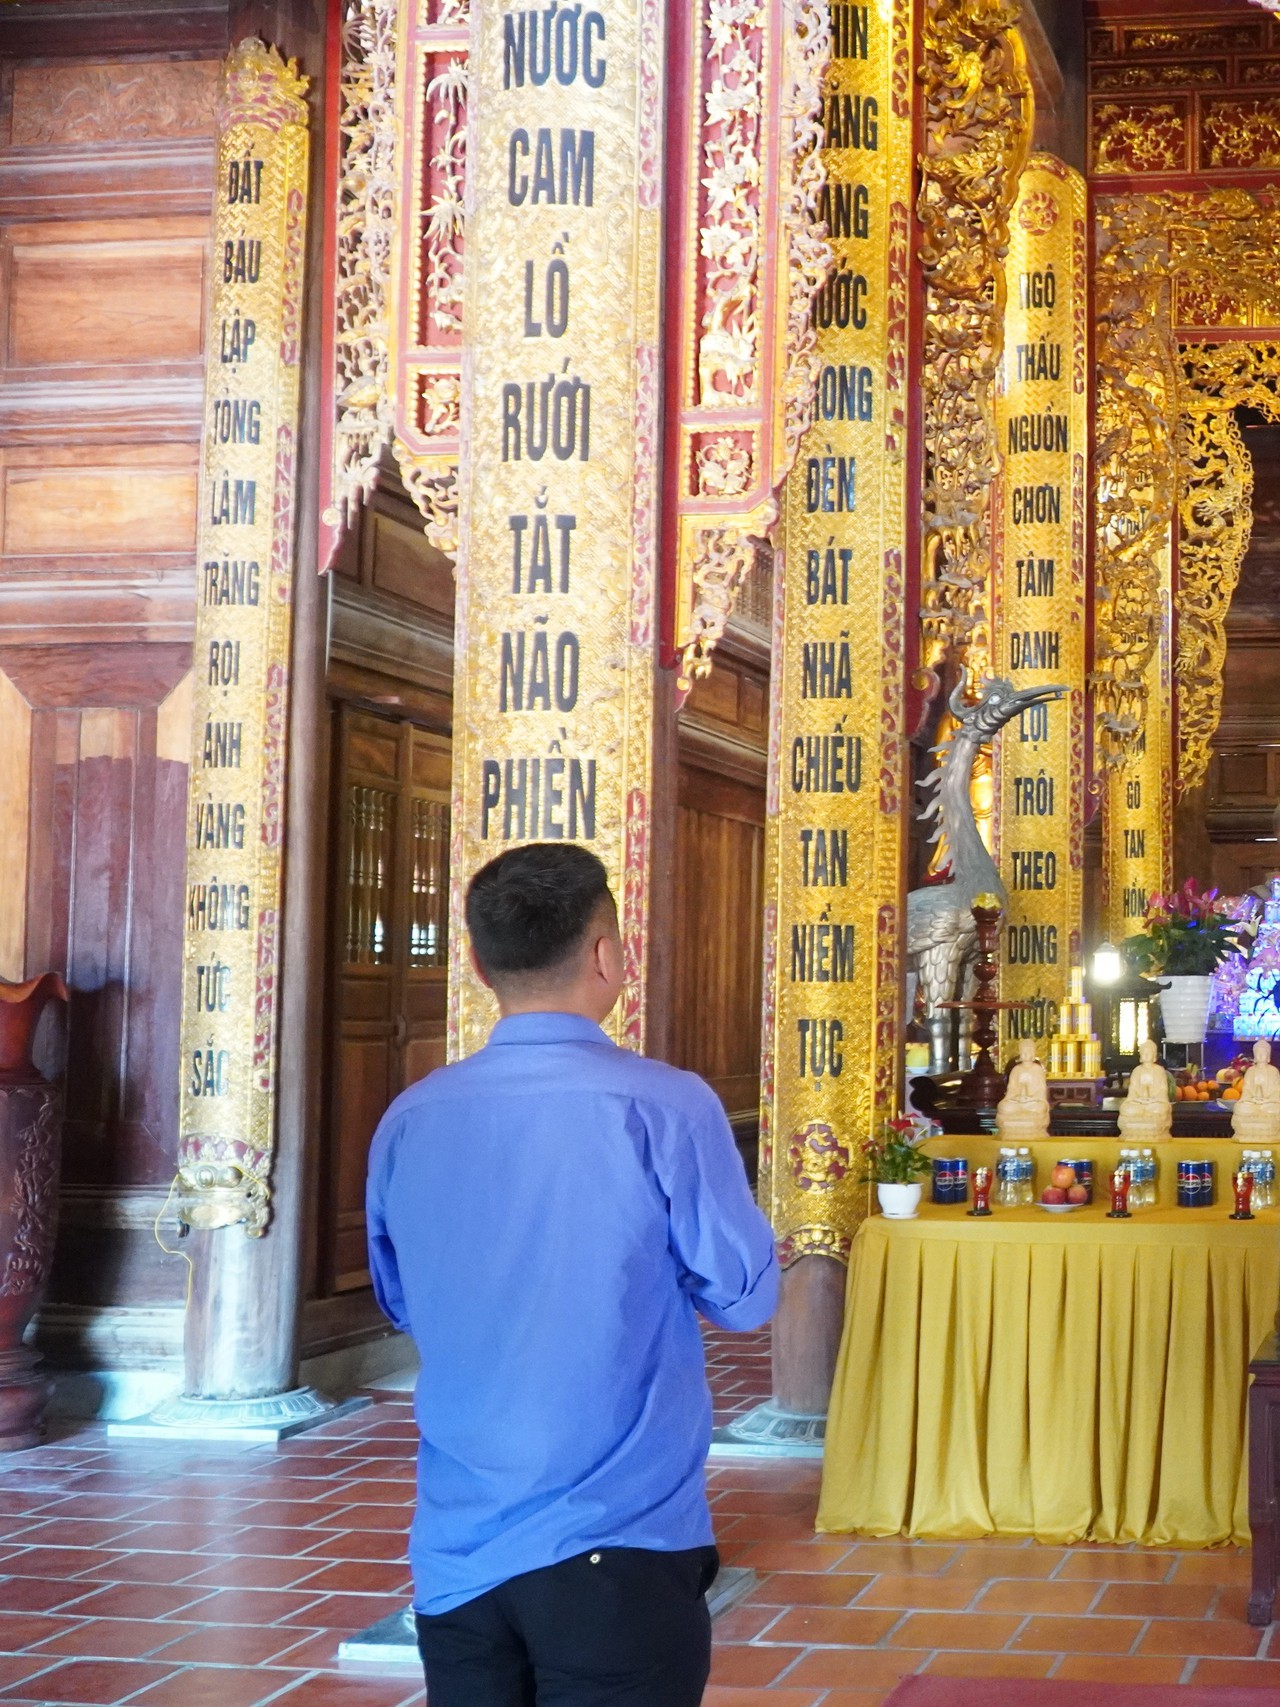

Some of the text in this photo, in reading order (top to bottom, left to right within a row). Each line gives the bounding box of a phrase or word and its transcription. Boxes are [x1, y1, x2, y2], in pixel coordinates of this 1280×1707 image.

[507, 127, 595, 208] CAM
[222, 228, 262, 284] BÁU
[523, 231, 570, 338] LỒ
[1018, 263, 1056, 318] NGỘ
[220, 307, 257, 375] LẬP
[1015, 332, 1062, 383] THẤU
[500, 356, 591, 463] RƯỚI
[1007, 401, 1069, 456] NGUỒN
[210, 469, 257, 526] LÂM
[806, 443, 857, 513] ĐÈN
[1011, 481, 1062, 526] CHƠN
[508, 484, 577, 595] TẮT
[805, 535, 854, 606] BÁT
[1015, 550, 1056, 599] TÂM
[207, 640, 241, 698] RỌI
[499, 614, 581, 713] NÃO
[802, 630, 852, 699] NHÃ
[1010, 631, 1060, 671] DANH
[201, 711, 243, 769] ÁNH
[790, 713, 862, 794] CHIẾU
[480, 726, 598, 841] PHIỀN
[1013, 769, 1055, 818] TRÔI
[195, 792, 246, 850] VÀNG
[1123, 829, 1146, 859] TAN
[799, 829, 848, 887] TAN
[1011, 849, 1057, 891] THEO
[186, 875, 250, 931] KHÔNG
[1007, 913, 1058, 966] DÒNG
[196, 951, 232, 1014] TỨC
[191, 1033, 231, 1098] SẮC
[797, 1018, 844, 1092] TỤC
